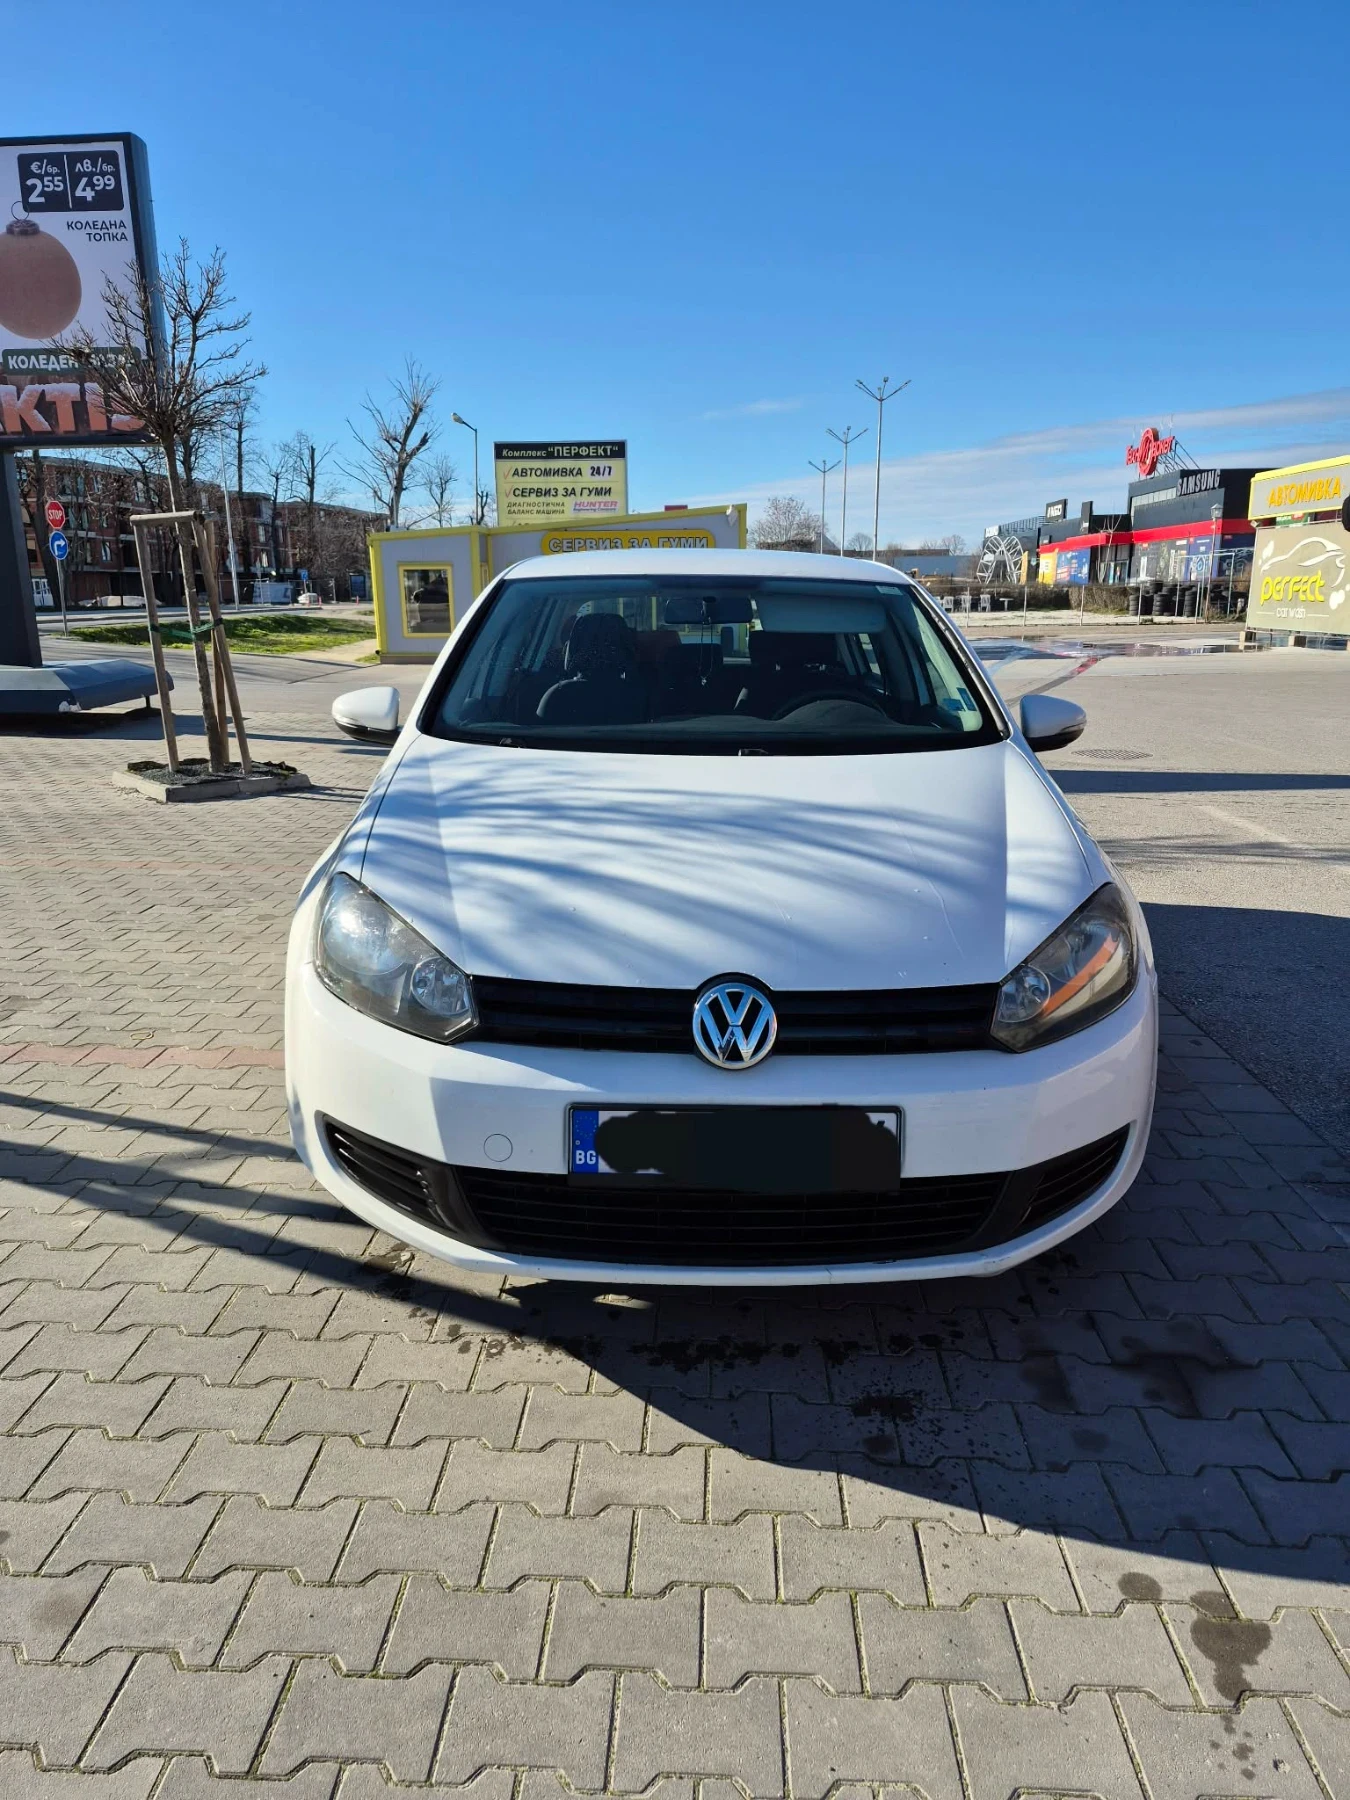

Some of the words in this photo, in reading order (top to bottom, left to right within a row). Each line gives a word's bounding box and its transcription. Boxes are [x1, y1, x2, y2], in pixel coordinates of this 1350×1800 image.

[66, 220, 127, 231] КОЛЕДНА
[86, 232, 128, 242] ТОПКА
[7, 354, 79, 371] КОЛЕДЕН
[502, 448, 547, 457] Комплекс
[512, 466, 583, 478] АВТОМИВКА
[590, 465, 612, 477] 24/7
[1176, 469, 1221, 497] SAMSUNG
[512, 487, 559, 498] СЕРВИЗ
[561, 486, 577, 497] ЗА
[580, 486, 612, 497] ГУМИ
[1267, 477, 1341, 508] АВТОМИВКА
[574, 500, 618, 508] HUNTER
[48, 509, 63, 520] STOP
[548, 537, 624, 553] СЕРВИЗ
[628, 537, 652, 550] ЗА
[658, 536, 709, 549] ГУМИ
[575, 1149, 597, 1165] BG
